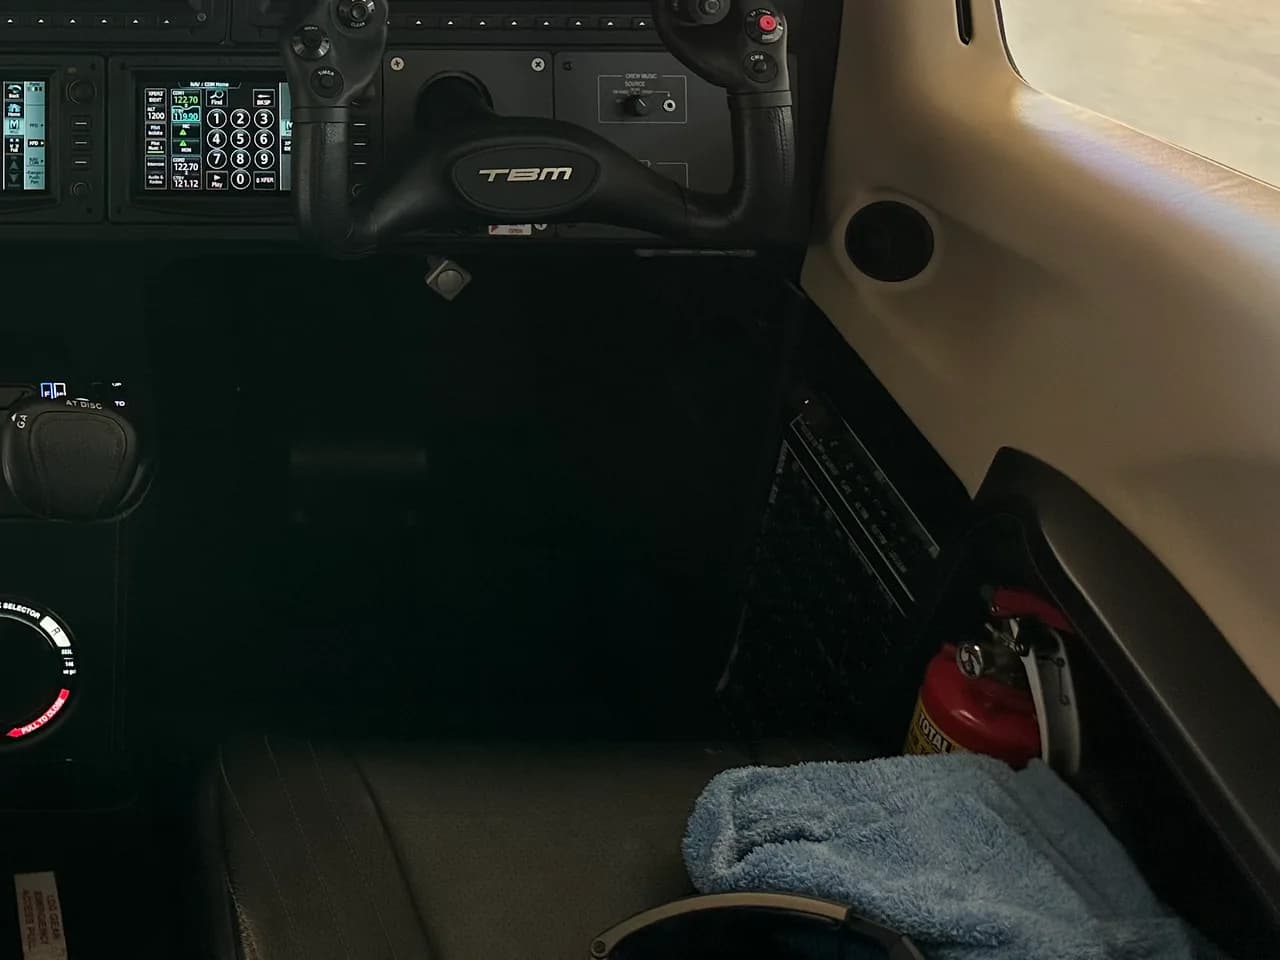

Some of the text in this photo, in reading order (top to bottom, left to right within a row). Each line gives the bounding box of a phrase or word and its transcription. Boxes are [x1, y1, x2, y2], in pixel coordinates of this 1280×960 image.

[174, 95, 199, 104] 122.70
[214, 113, 268, 124] 1 2 3
[212, 134, 268, 145] 4 5 6
[213, 154, 268, 165] 7 8 9
[174, 163, 199, 171] 122.70
[237, 174, 245, 185] 0
[479, 168, 572, 182] TBM
[174, 180, 199, 188] 121.12
[80, 401, 103, 410] DISC
[3, 602, 41, 619] SELECTOR
